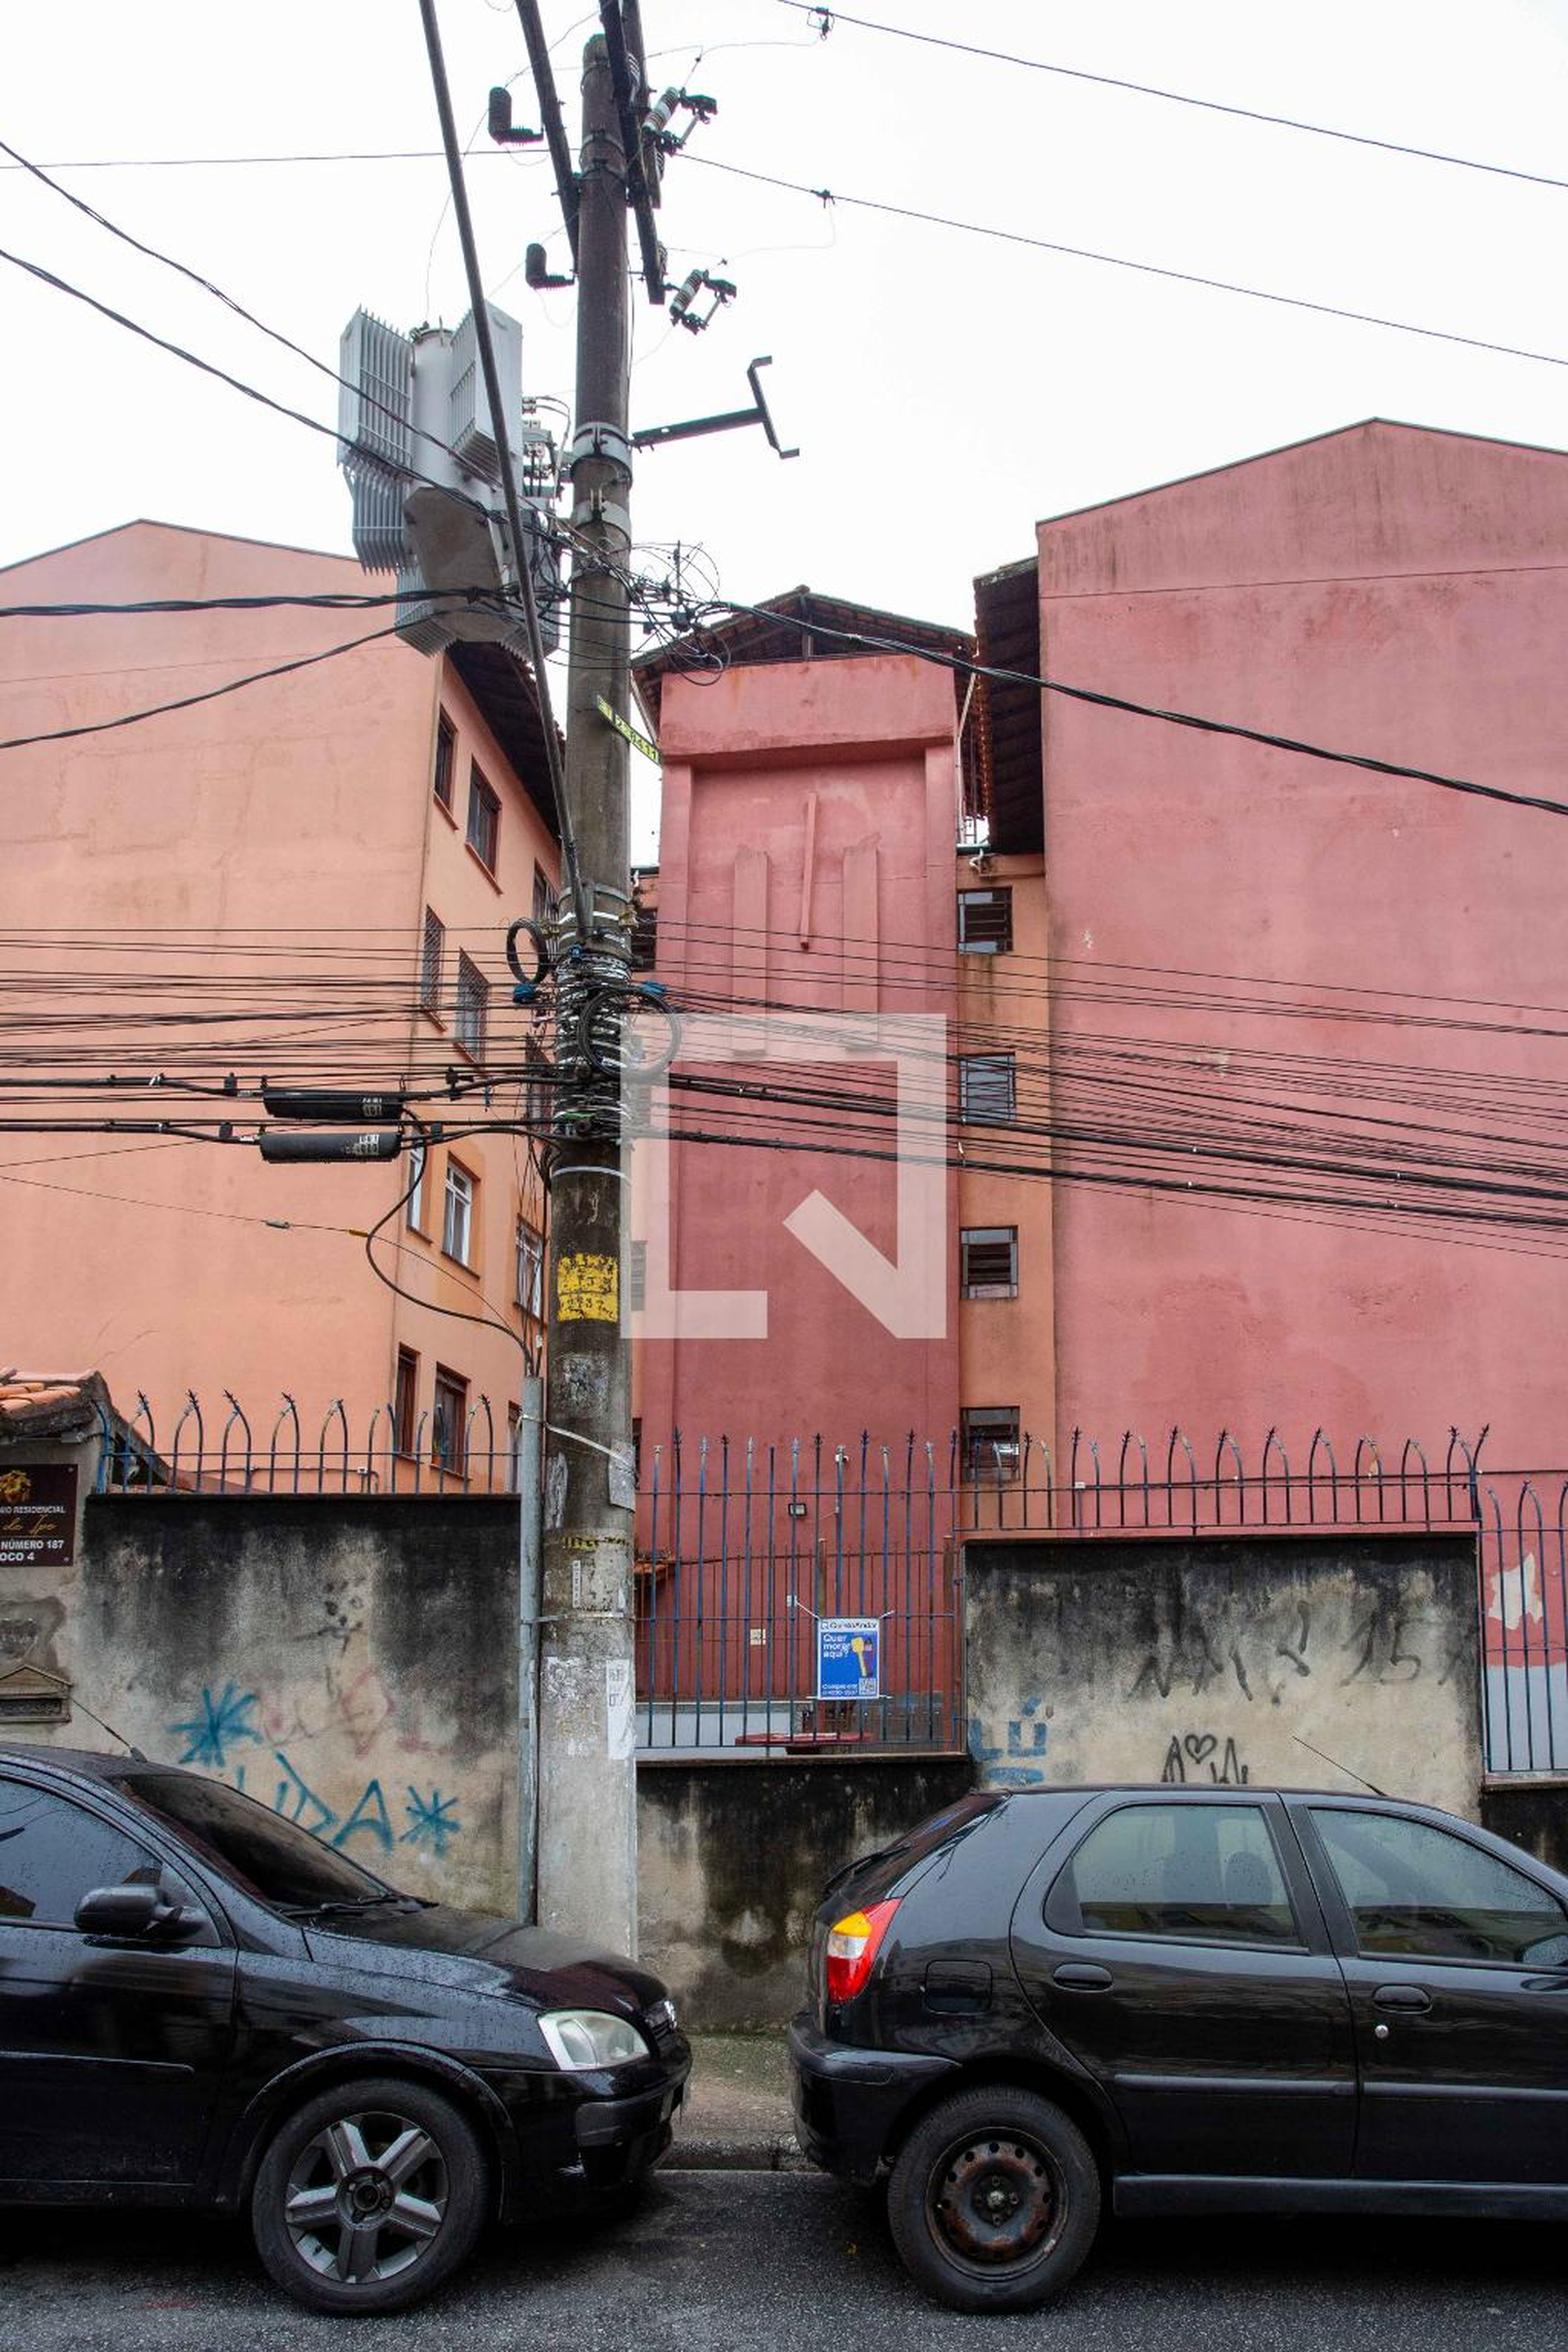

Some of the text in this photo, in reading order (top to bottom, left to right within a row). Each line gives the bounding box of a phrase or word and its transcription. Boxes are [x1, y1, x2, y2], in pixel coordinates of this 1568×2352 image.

[1, 1539, 65, 1550] NÚMERO 187
[27, 1552, 35, 1561] 4
[823, 1634, 847, 1642] Quer
[823, 1650, 849, 1659] aqui?
